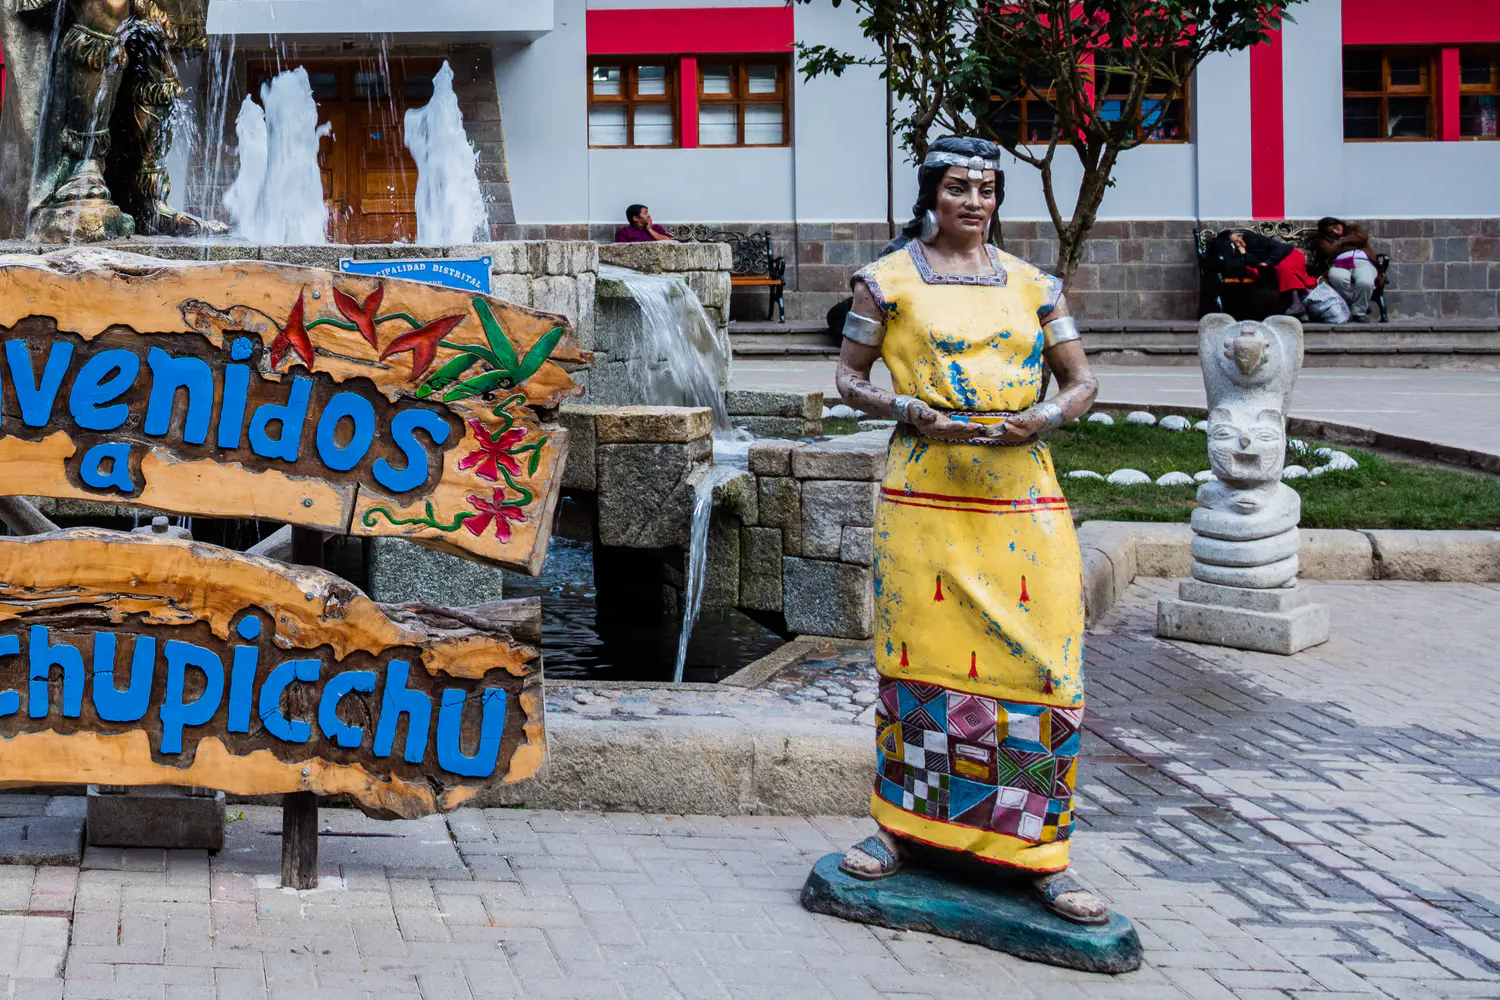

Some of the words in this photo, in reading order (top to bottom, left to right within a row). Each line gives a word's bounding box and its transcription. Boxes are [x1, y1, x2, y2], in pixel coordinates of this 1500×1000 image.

[376, 263, 426, 277] CIPALIDAD
[432, 264, 482, 289] DISTRITAL
[80, 442, 134, 491] a
